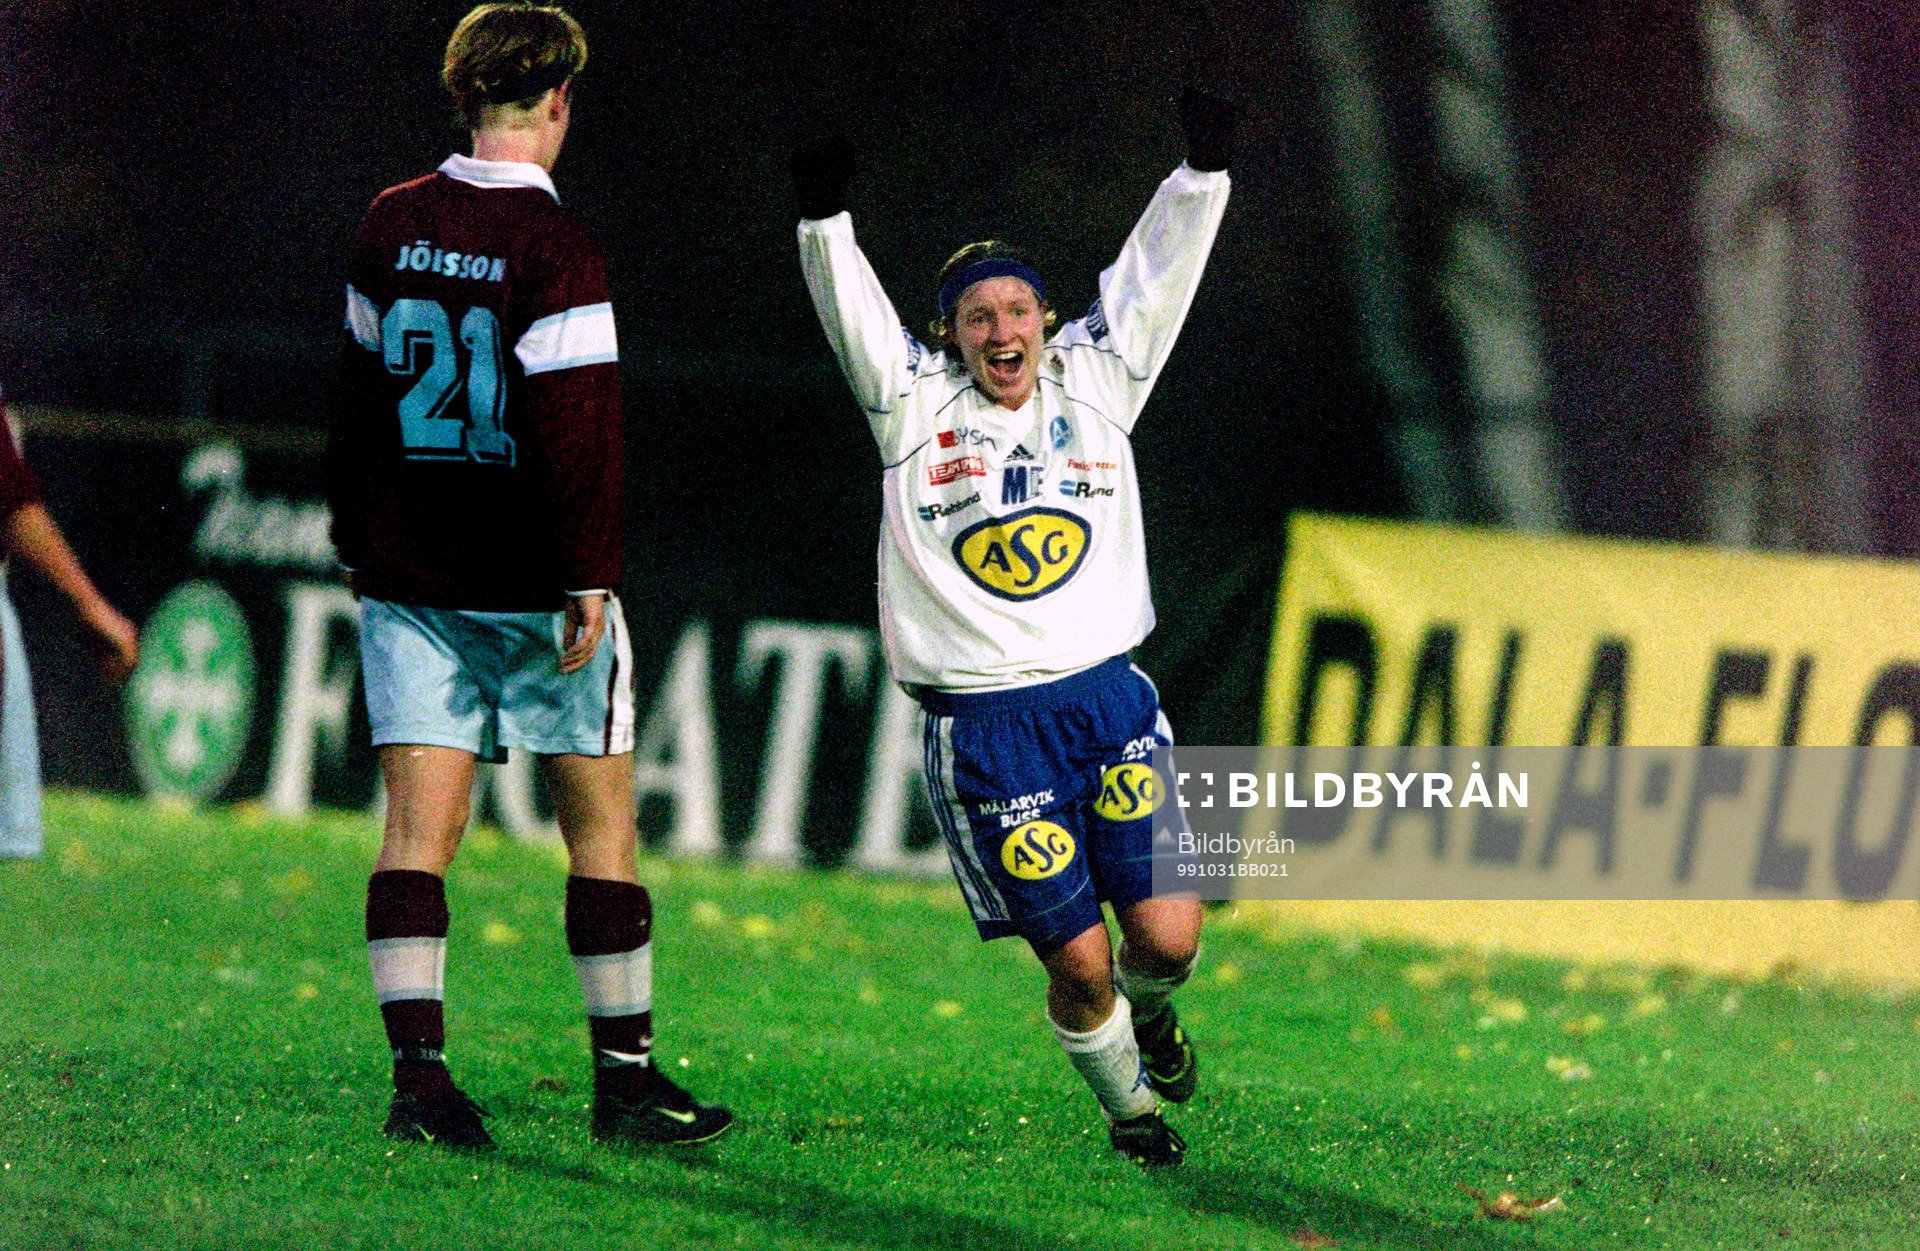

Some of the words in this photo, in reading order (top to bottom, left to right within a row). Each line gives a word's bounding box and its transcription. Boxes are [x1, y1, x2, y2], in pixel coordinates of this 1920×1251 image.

[382, 299, 516, 467] 21
[980, 525, 1069, 588] ASG
[1014, 827, 1068, 873] ASG
